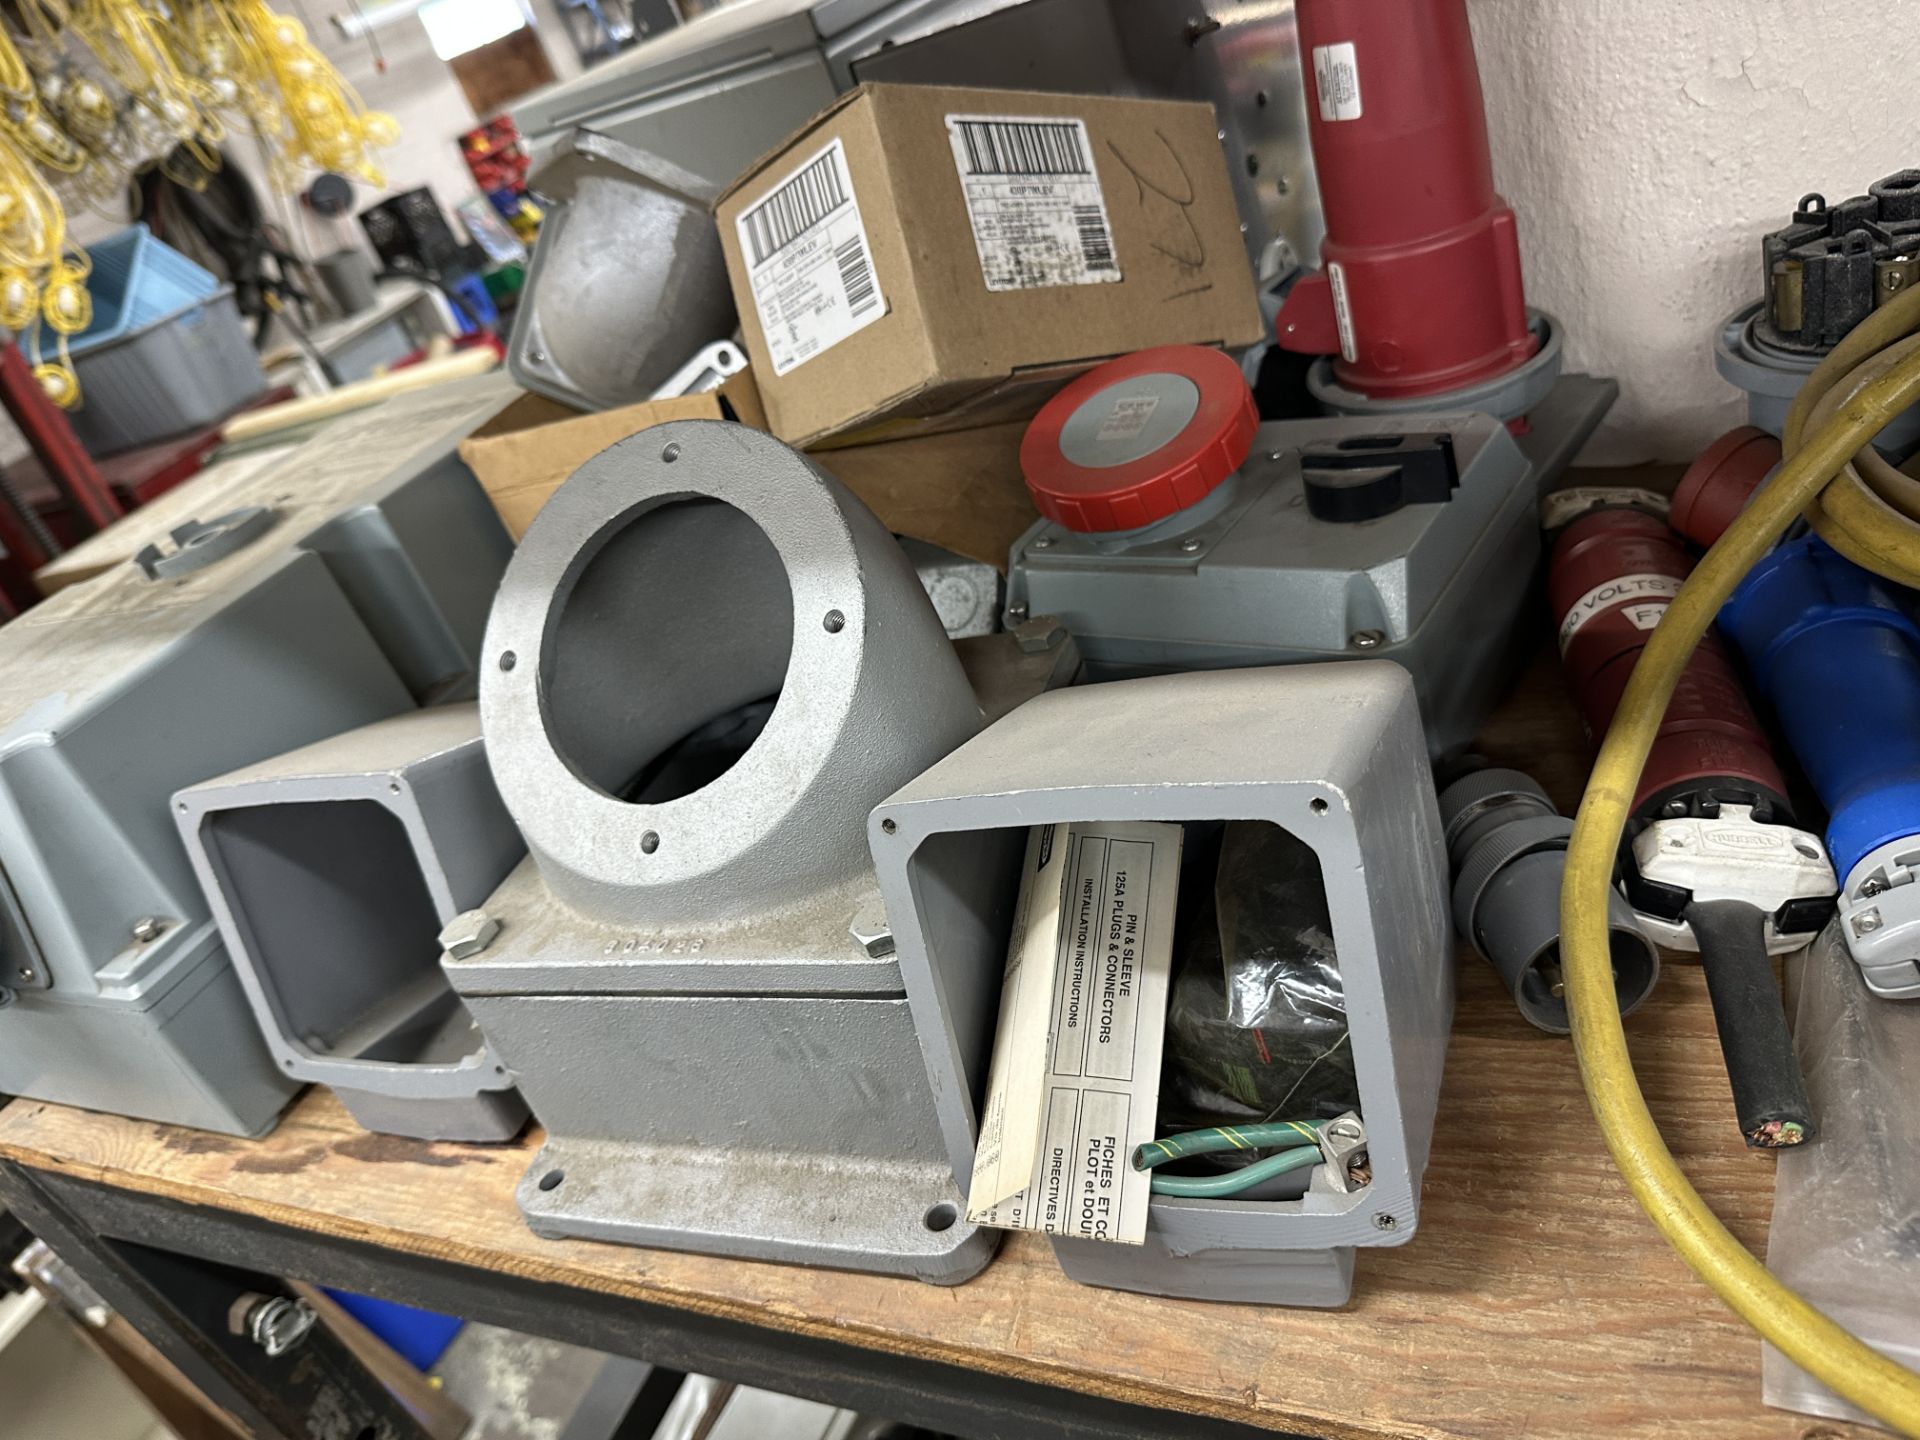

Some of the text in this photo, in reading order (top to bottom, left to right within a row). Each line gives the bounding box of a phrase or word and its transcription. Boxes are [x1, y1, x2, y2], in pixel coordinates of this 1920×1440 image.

[1583, 580, 1666, 609] VOLTS
[1067, 878, 1093, 1028] INSTALLATION INSTRUCTIONS
[1099, 871, 1127, 1044] 125A PLUGS & CONNECTORS
[1119, 914, 1138, 997] PIN & SLEEVE
[1046, 1147, 1063, 1220] DIRECTIVES
[1086, 1139, 1101, 1177] PLOT
[1099, 1136, 1116, 1189] FICHES
[1084, 1180, 1095, 1194] et
[1097, 1196, 1110, 1216] ET
